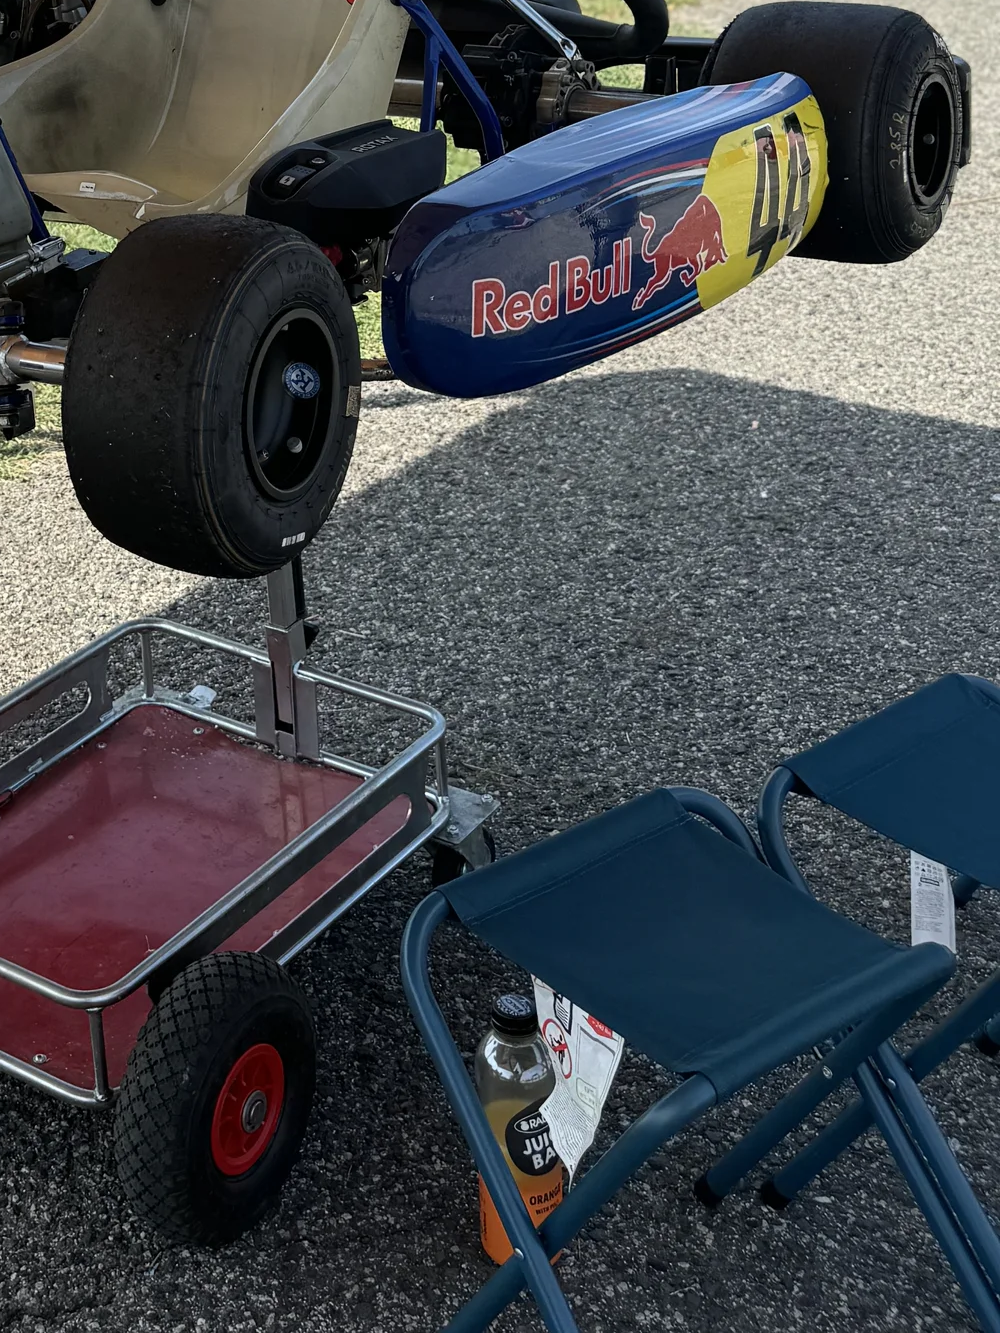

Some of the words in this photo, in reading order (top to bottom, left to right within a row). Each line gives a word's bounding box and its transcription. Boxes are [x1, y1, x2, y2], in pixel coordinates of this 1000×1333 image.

[351, 135, 399, 153] ROTAX
[471, 260, 560, 338] Red
[565, 237, 632, 315] Bull
